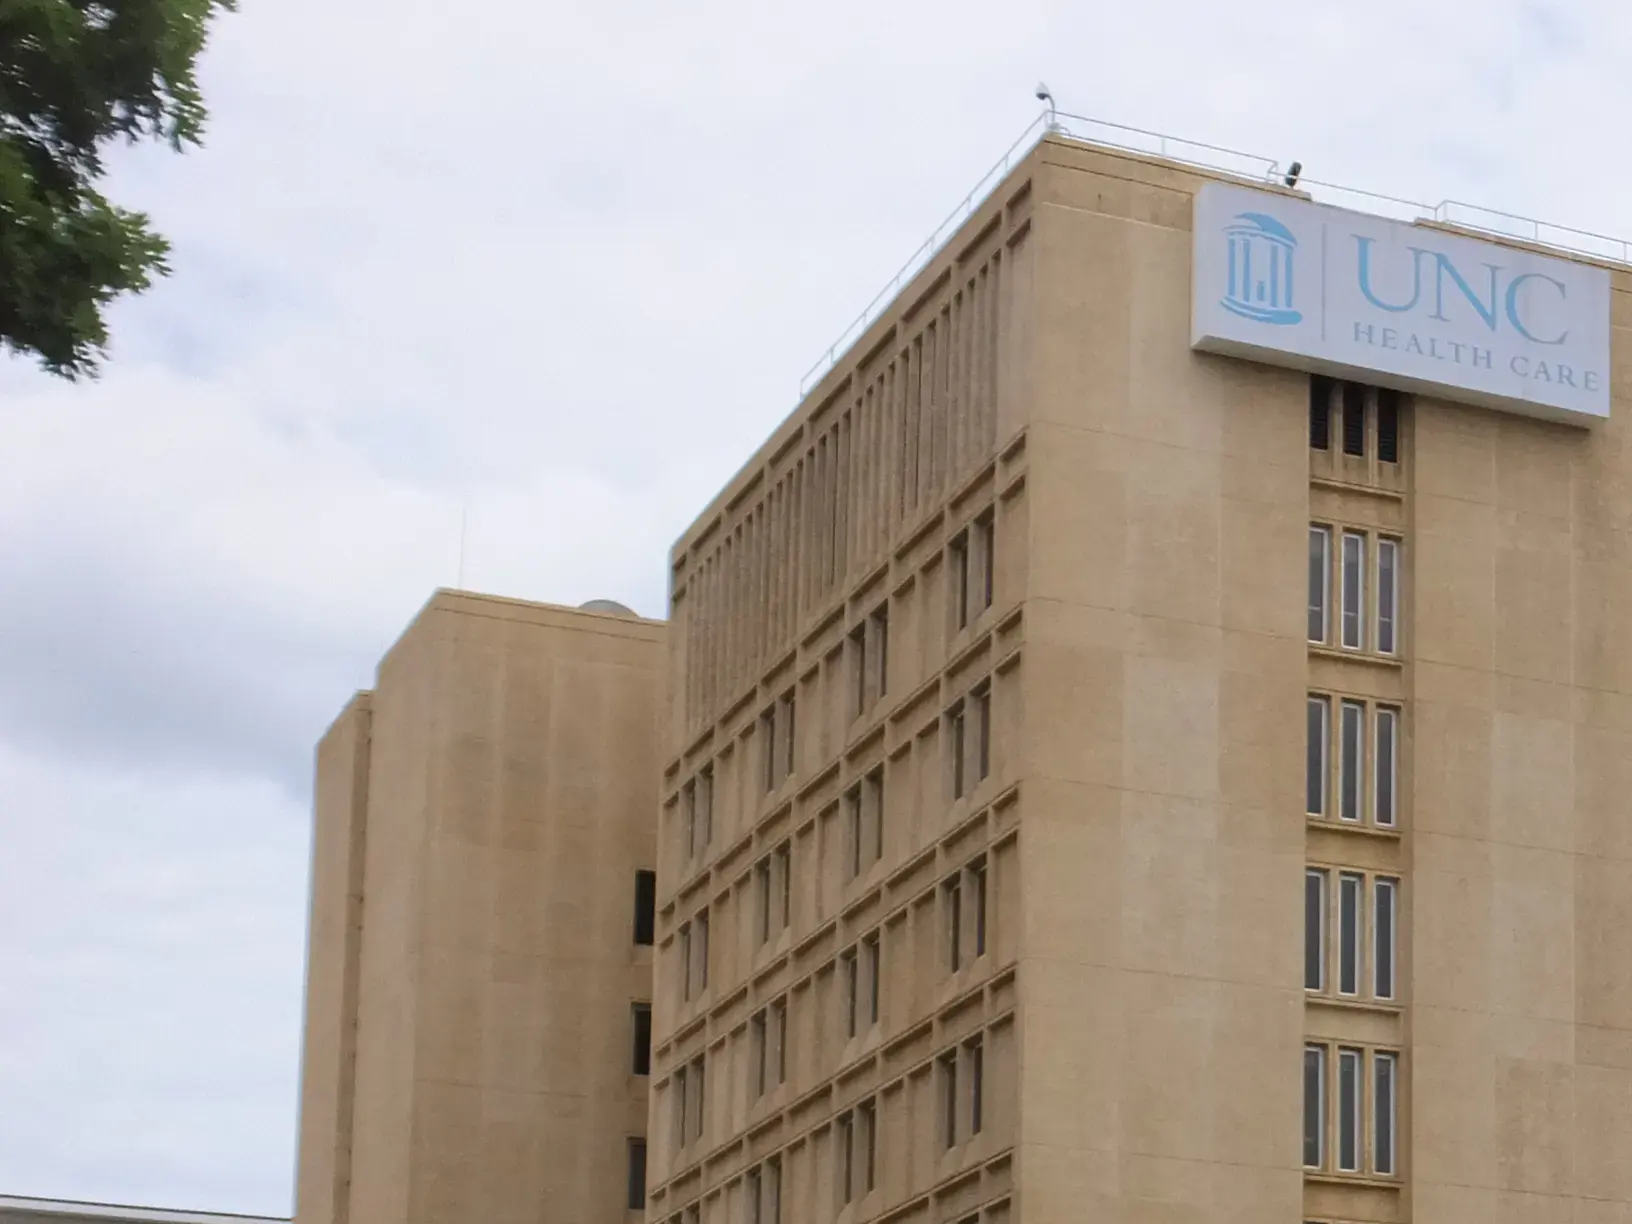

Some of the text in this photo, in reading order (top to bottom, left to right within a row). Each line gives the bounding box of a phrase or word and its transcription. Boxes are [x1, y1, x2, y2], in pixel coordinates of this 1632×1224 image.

[1350, 234, 1569, 345] UNC
[1353, 321, 1599, 391] HEALTH CARE
